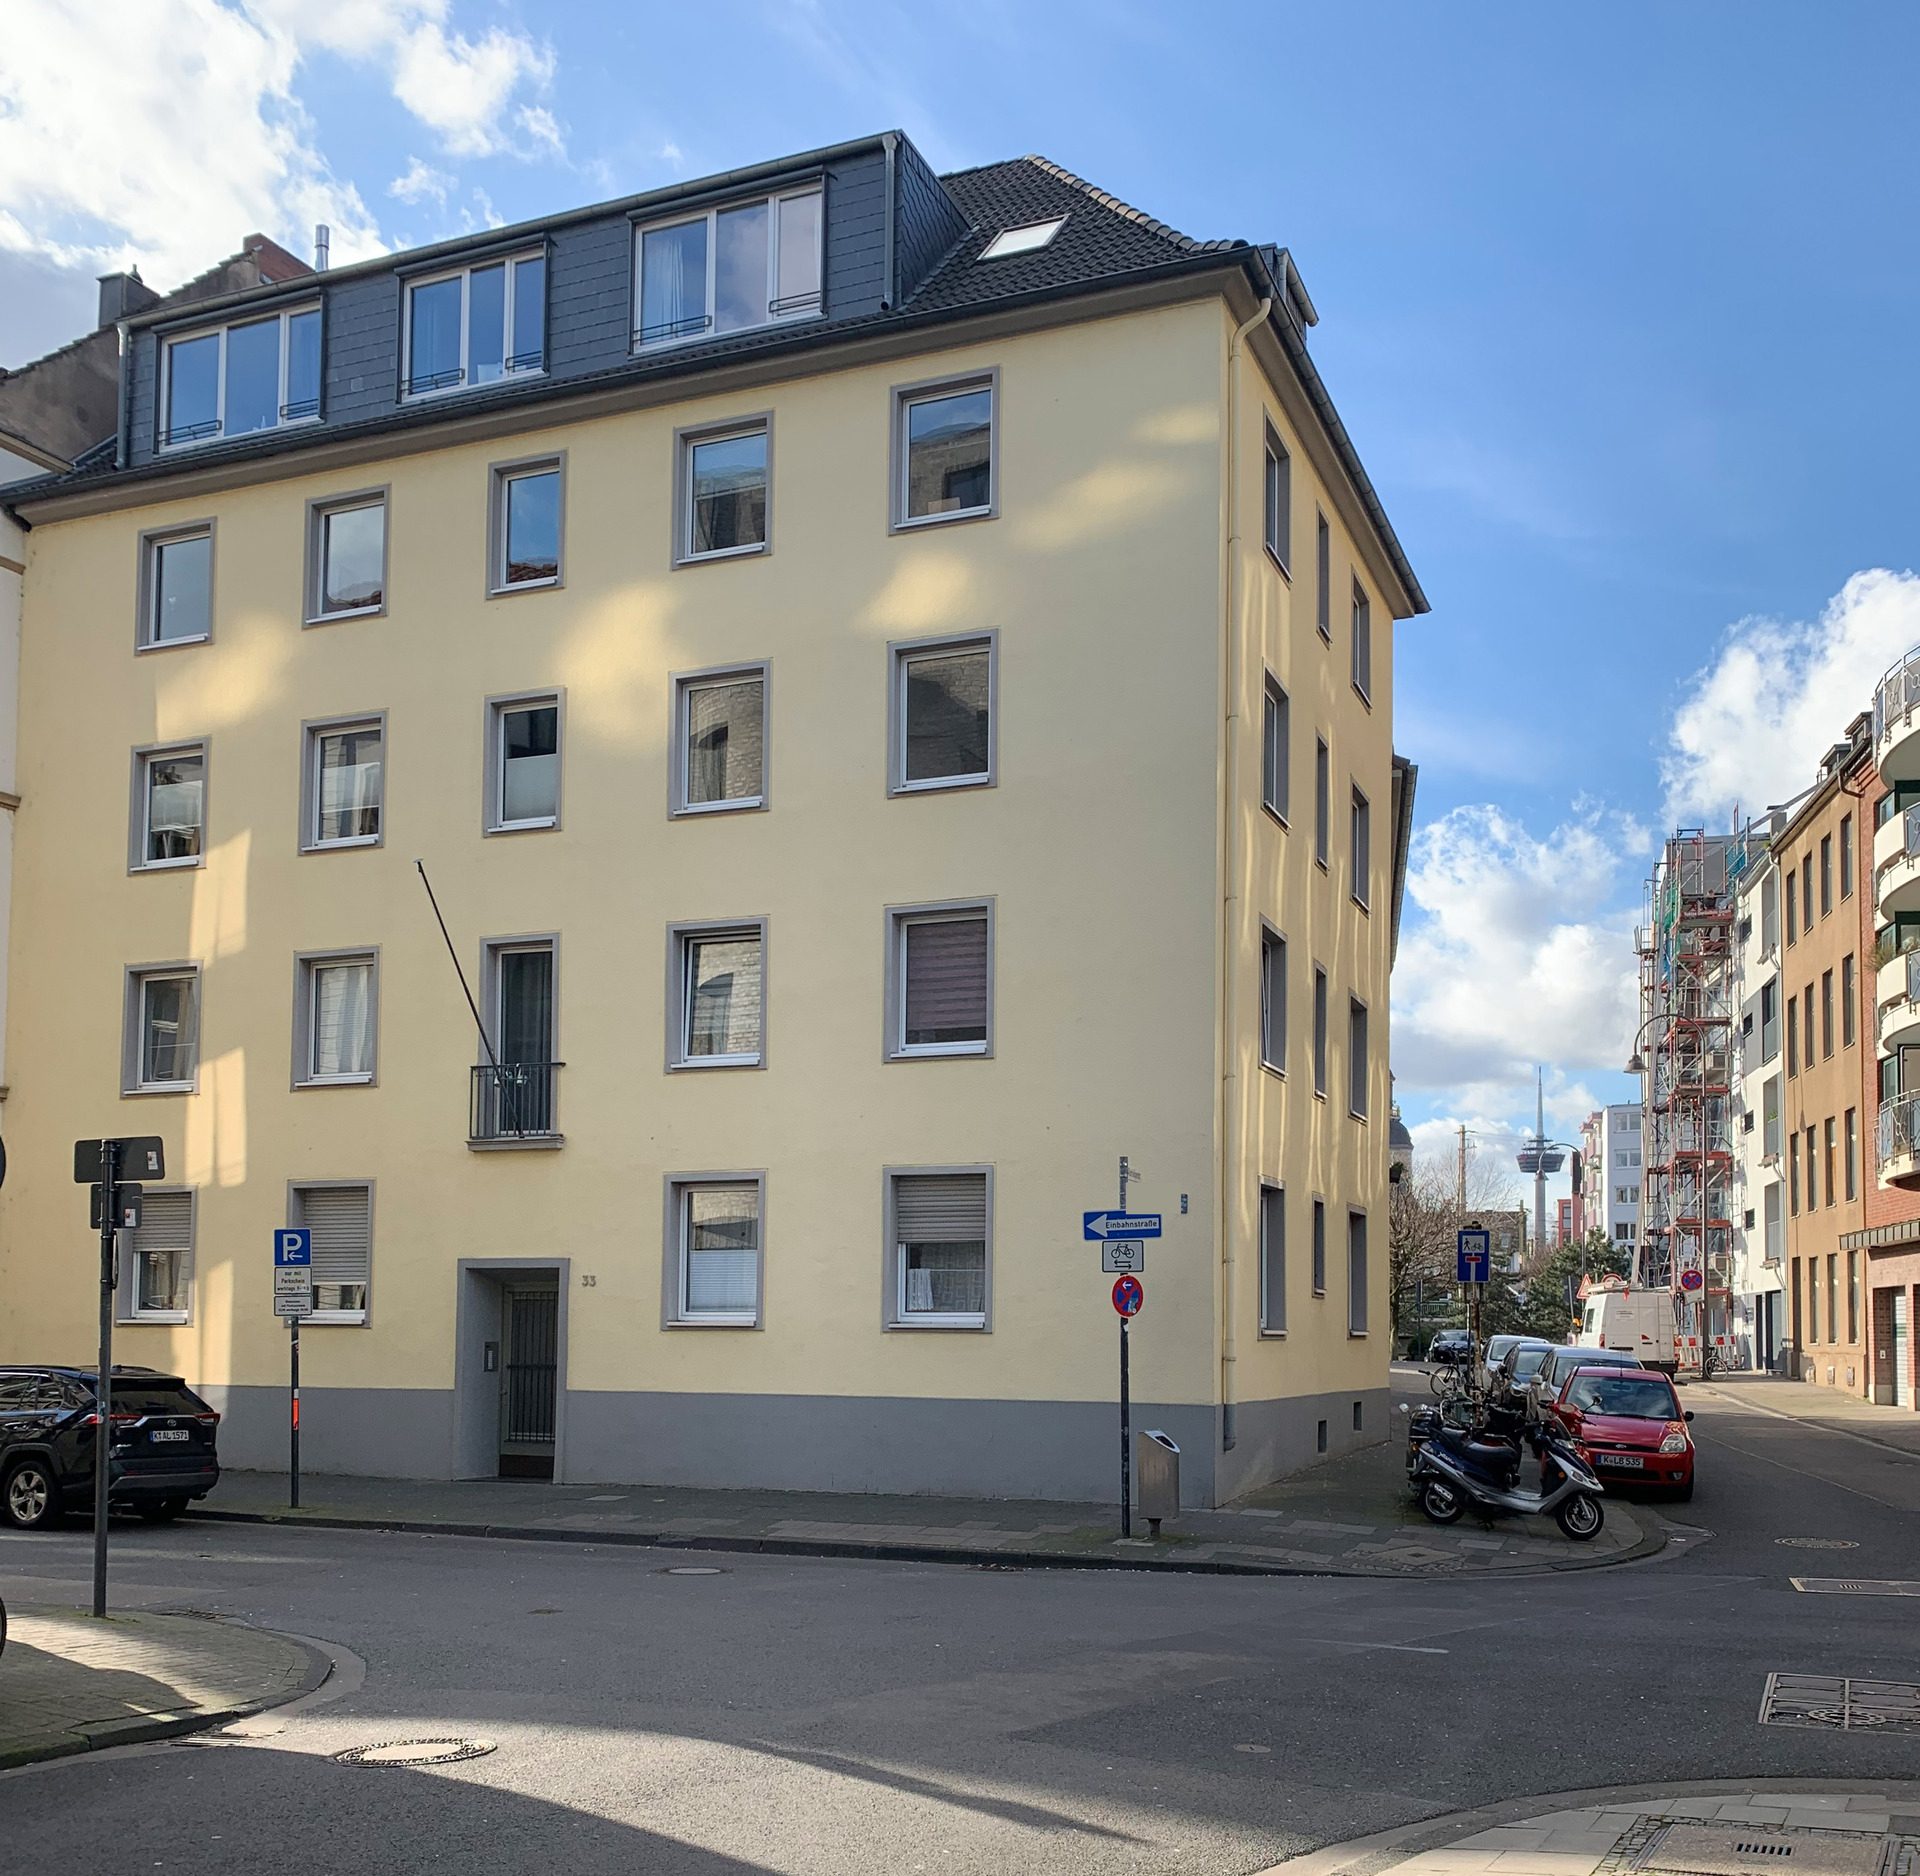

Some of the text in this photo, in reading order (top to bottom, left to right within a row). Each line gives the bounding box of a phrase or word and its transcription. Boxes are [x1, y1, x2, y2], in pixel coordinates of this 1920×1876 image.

[1105, 1220, 1157, 1229] Einbahnstraße
[283, 1234, 302, 1261] P
[581, 1275, 596, 1287] 33
[1625, 1457, 1641, 1466] 535
